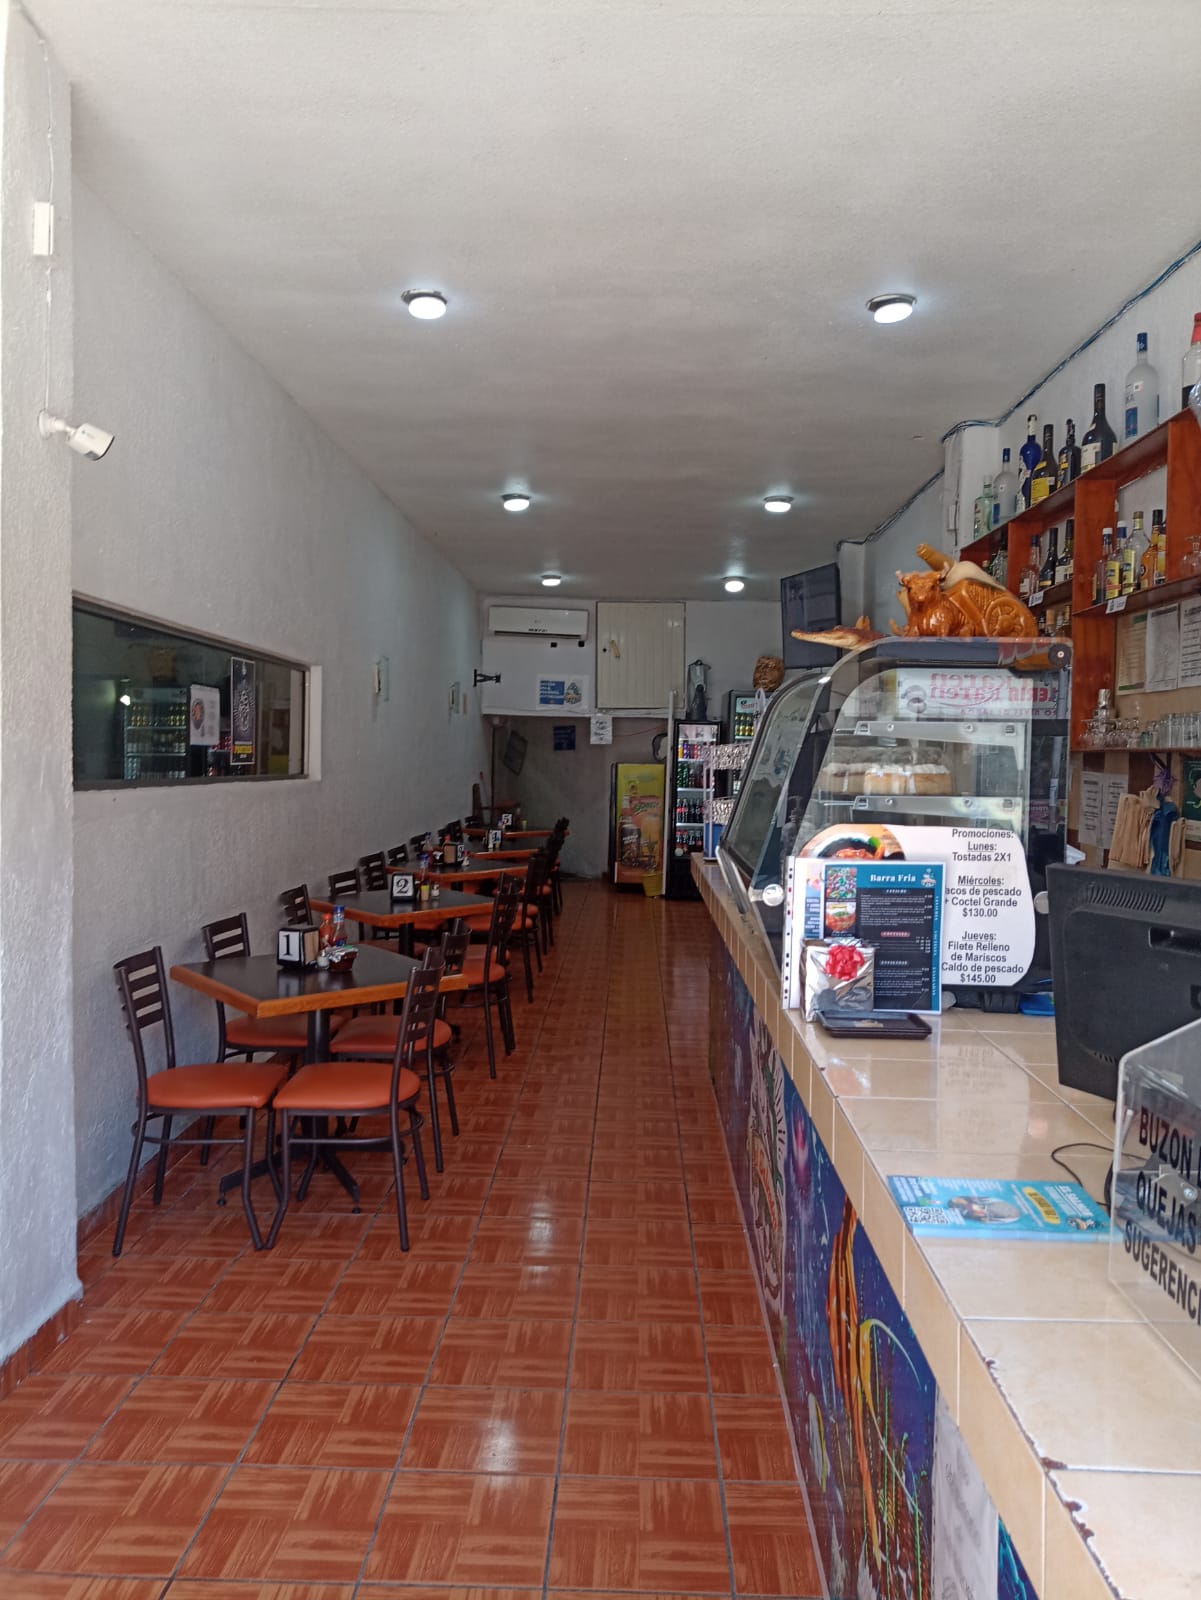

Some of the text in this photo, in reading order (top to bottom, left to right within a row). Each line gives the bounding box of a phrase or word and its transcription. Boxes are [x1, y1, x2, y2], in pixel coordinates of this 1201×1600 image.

[952, 828, 1014, 839] Promociones:
[968, 841, 997, 852] Lunes:
[952, 852, 1011, 862] Tostadas 2X1
[870, 874, 896, 882] Barra
[957, 875, 1005, 886] Miércoles:
[396, 878, 410, 894] 2
[945, 886, 1022, 898] acos de pescado
[951, 896, 981, 906] Coctel
[983, 897, 1018, 907] Grande
[962, 907, 998, 917] $130.00
[962, 930, 997, 941] Jueves:
[283, 934, 292, 956] 1
[948, 940, 973, 951] Filete
[976, 941, 1010, 952] Relleno
[951, 952, 1007, 963] de Mariscos
[942, 962, 1024, 974] Caldo de pescado
[960, 973, 996, 983] $145.00
[1139, 1104, 1192, 1179] BUZON
[1136, 1171, 1197, 1254] QUEJAS
